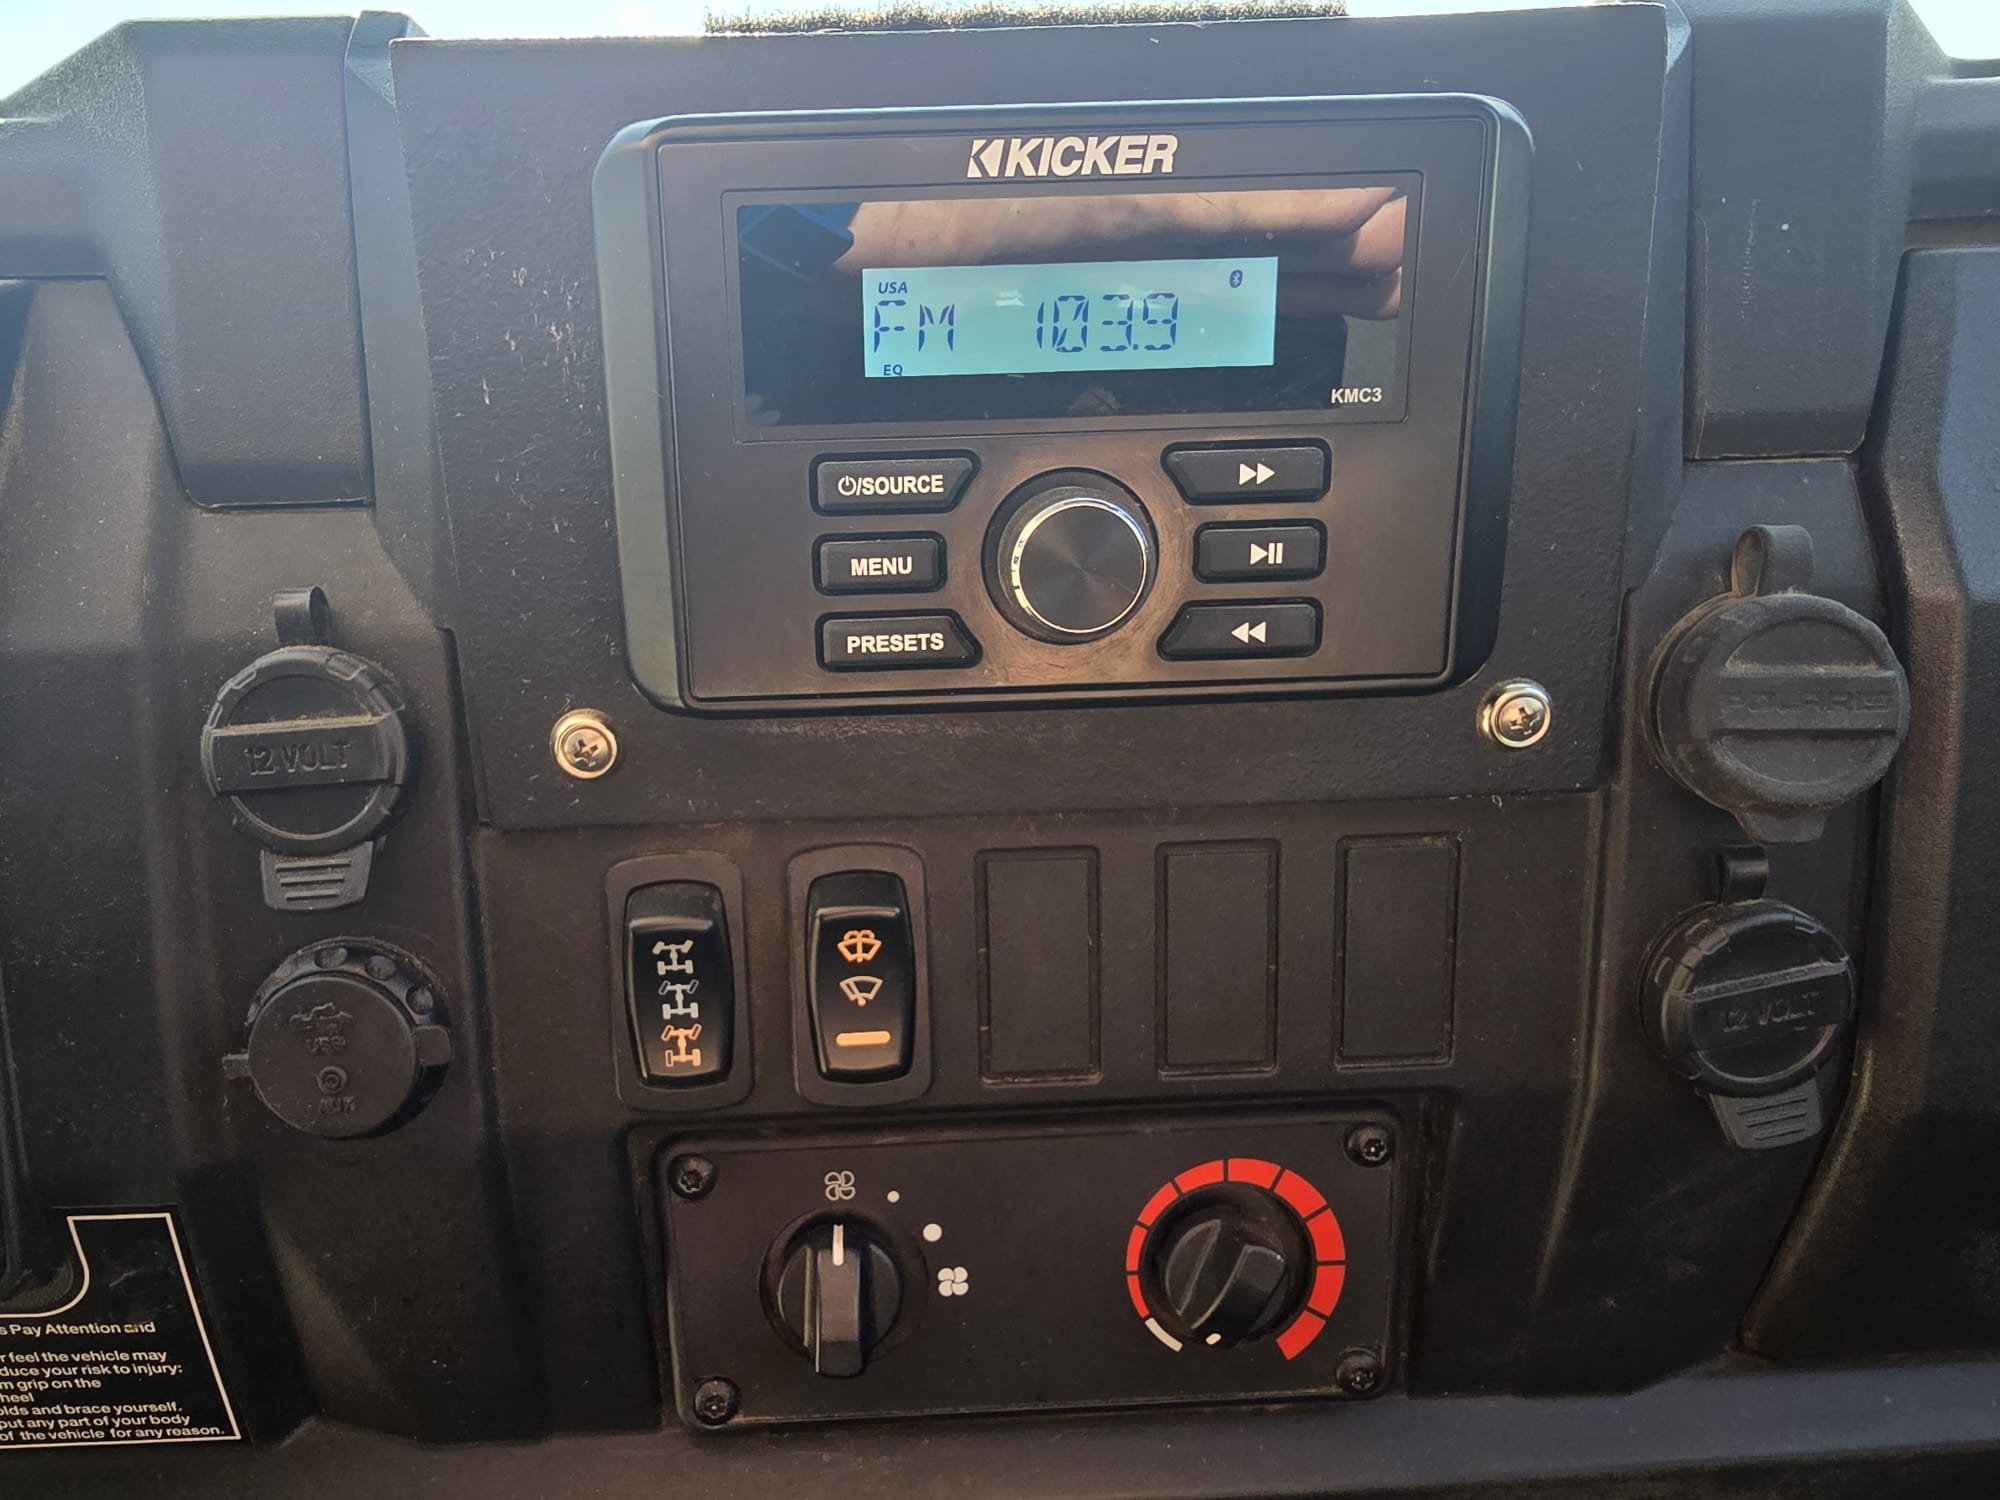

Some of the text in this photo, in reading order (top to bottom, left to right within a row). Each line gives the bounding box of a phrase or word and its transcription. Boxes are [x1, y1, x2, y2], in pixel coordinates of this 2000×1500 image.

[1004, 134, 1178, 177] KICKER
[878, 281, 908, 294] USA
[873, 292, 1179, 353] FM 103.9
[883, 364, 903, 377] EQ
[1331, 387, 1383, 404] KMC3
[850, 556, 913, 577] MENU
[846, 632, 944, 654] PRESETS
[243, 743, 351, 776] 12 VOLT
[9, 1324, 41, 1338] Pay
[45, 1323, 121, 1335] Attention
[123, 1321, 157, 1334] and
[8, 1351, 40, 1363] feel
[41, 1351, 69, 1362] the
[71, 1350, 130, 1362] vehicle
[132, 1351, 167, 1363] may
[41, 1366, 79, 1378] your
[81, 1364, 112, 1375] risk
[112, 1364, 130, 1374] to
[132, 1363, 183, 1377] injury:
[16, 1379, 49, 1392] grip
[51, 1380, 73, 1389] on
[74, 1378, 101, 1389] the
[31, 1404, 62, 1415] and
[63, 1404, 111, 1415] brace
[113, 1402, 183, 1416] yourself.
[0, 1414, 190, 1431] put any part of your body
[0, 1426, 225, 1441] of the vehicle for any reason.
